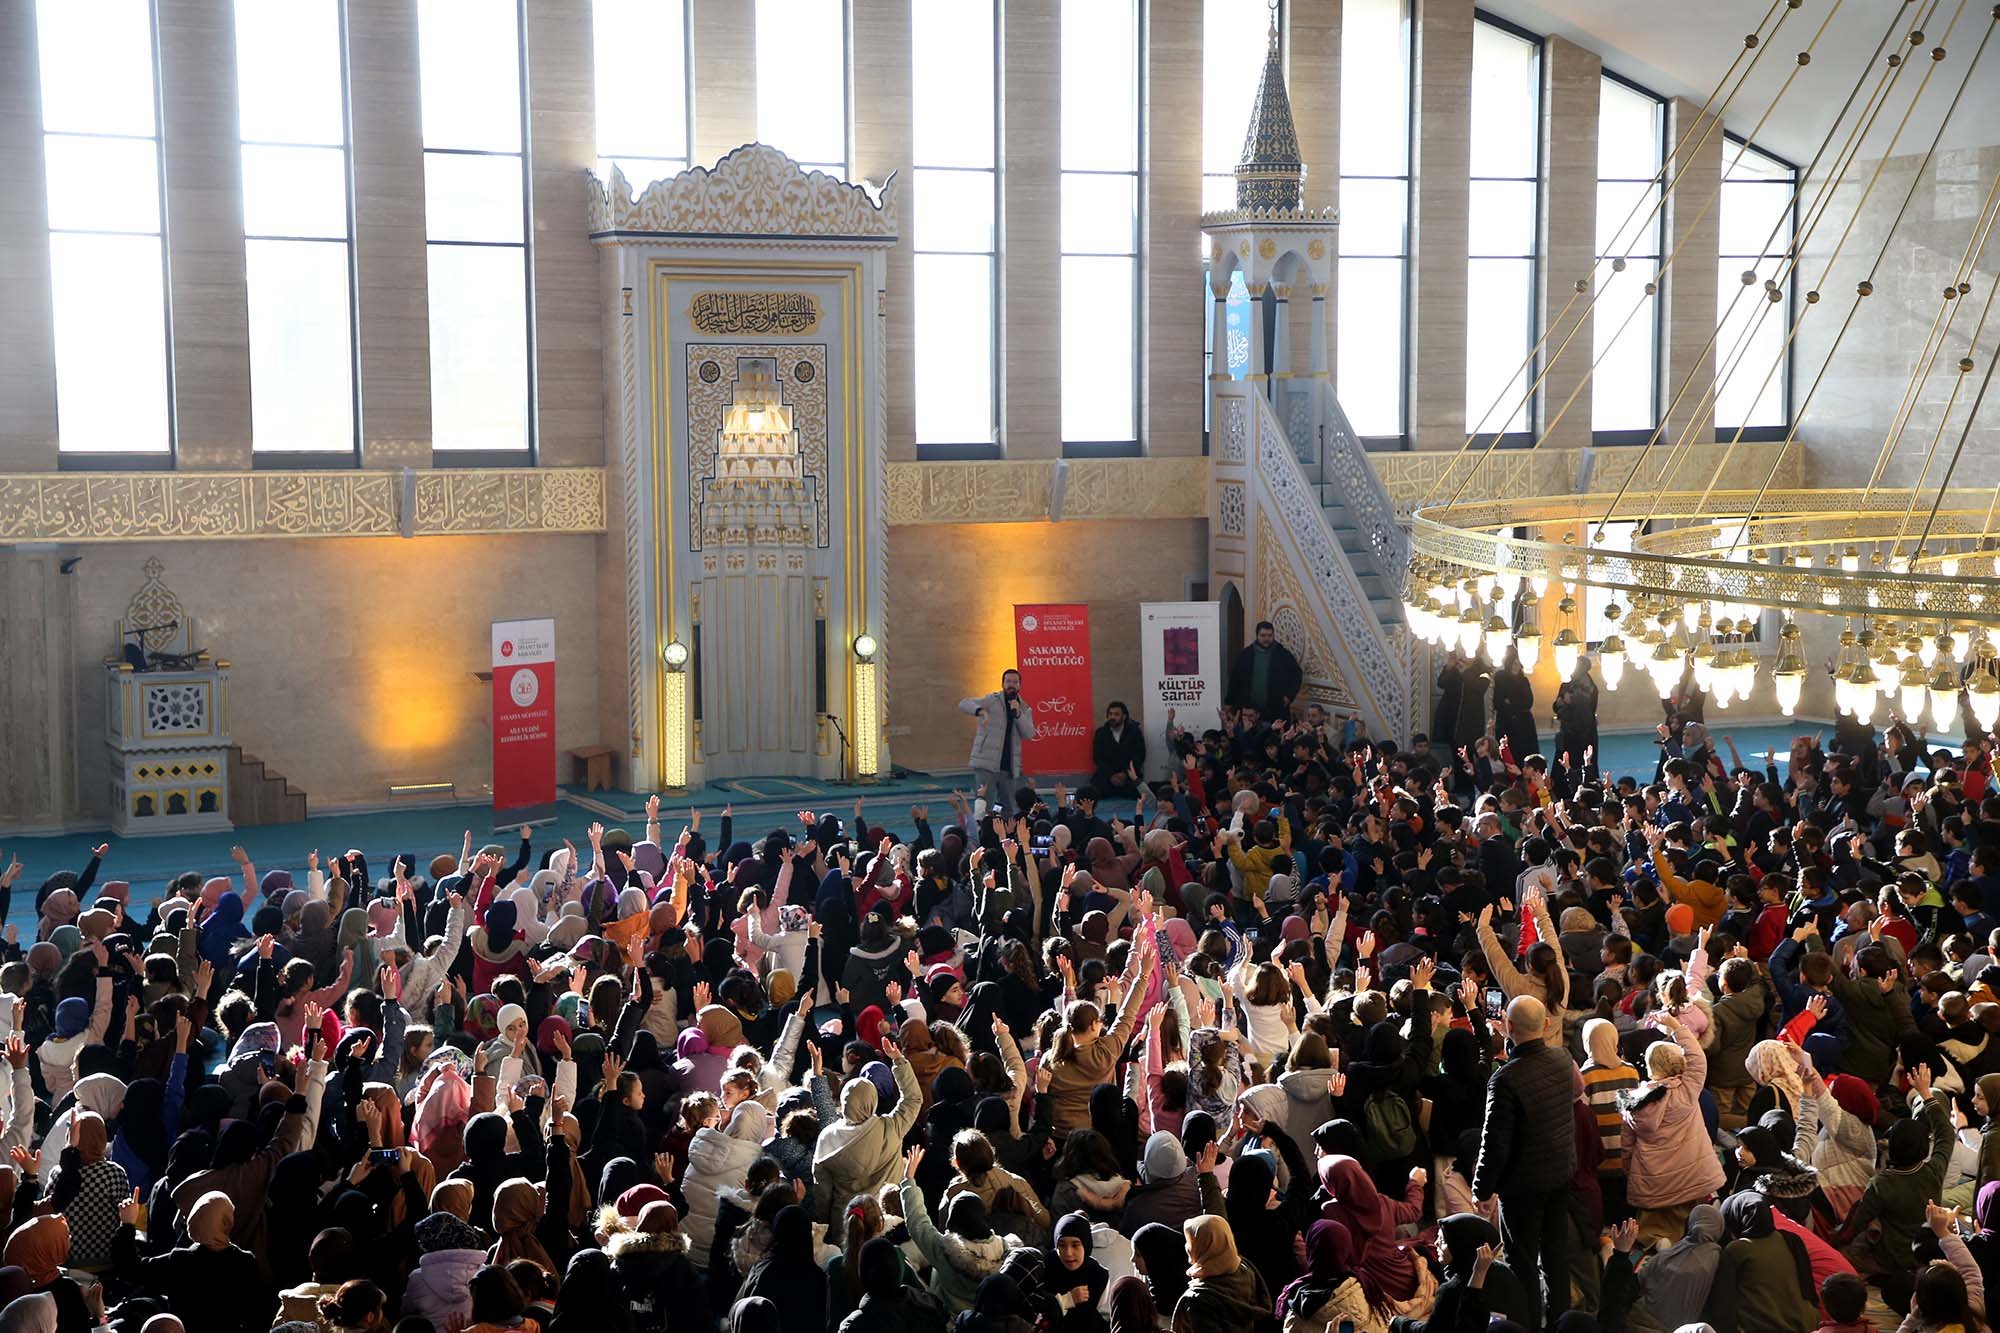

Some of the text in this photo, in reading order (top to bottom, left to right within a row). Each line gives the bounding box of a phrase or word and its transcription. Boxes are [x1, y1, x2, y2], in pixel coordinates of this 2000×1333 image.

[1029, 646, 1075, 655] SAKARYA
[1023, 656, 1084, 666] MÜFTÜLÜĞÜ
[1037, 696, 1076, 716] Hoş
[1032, 721, 1087, 741] Geldiniz
